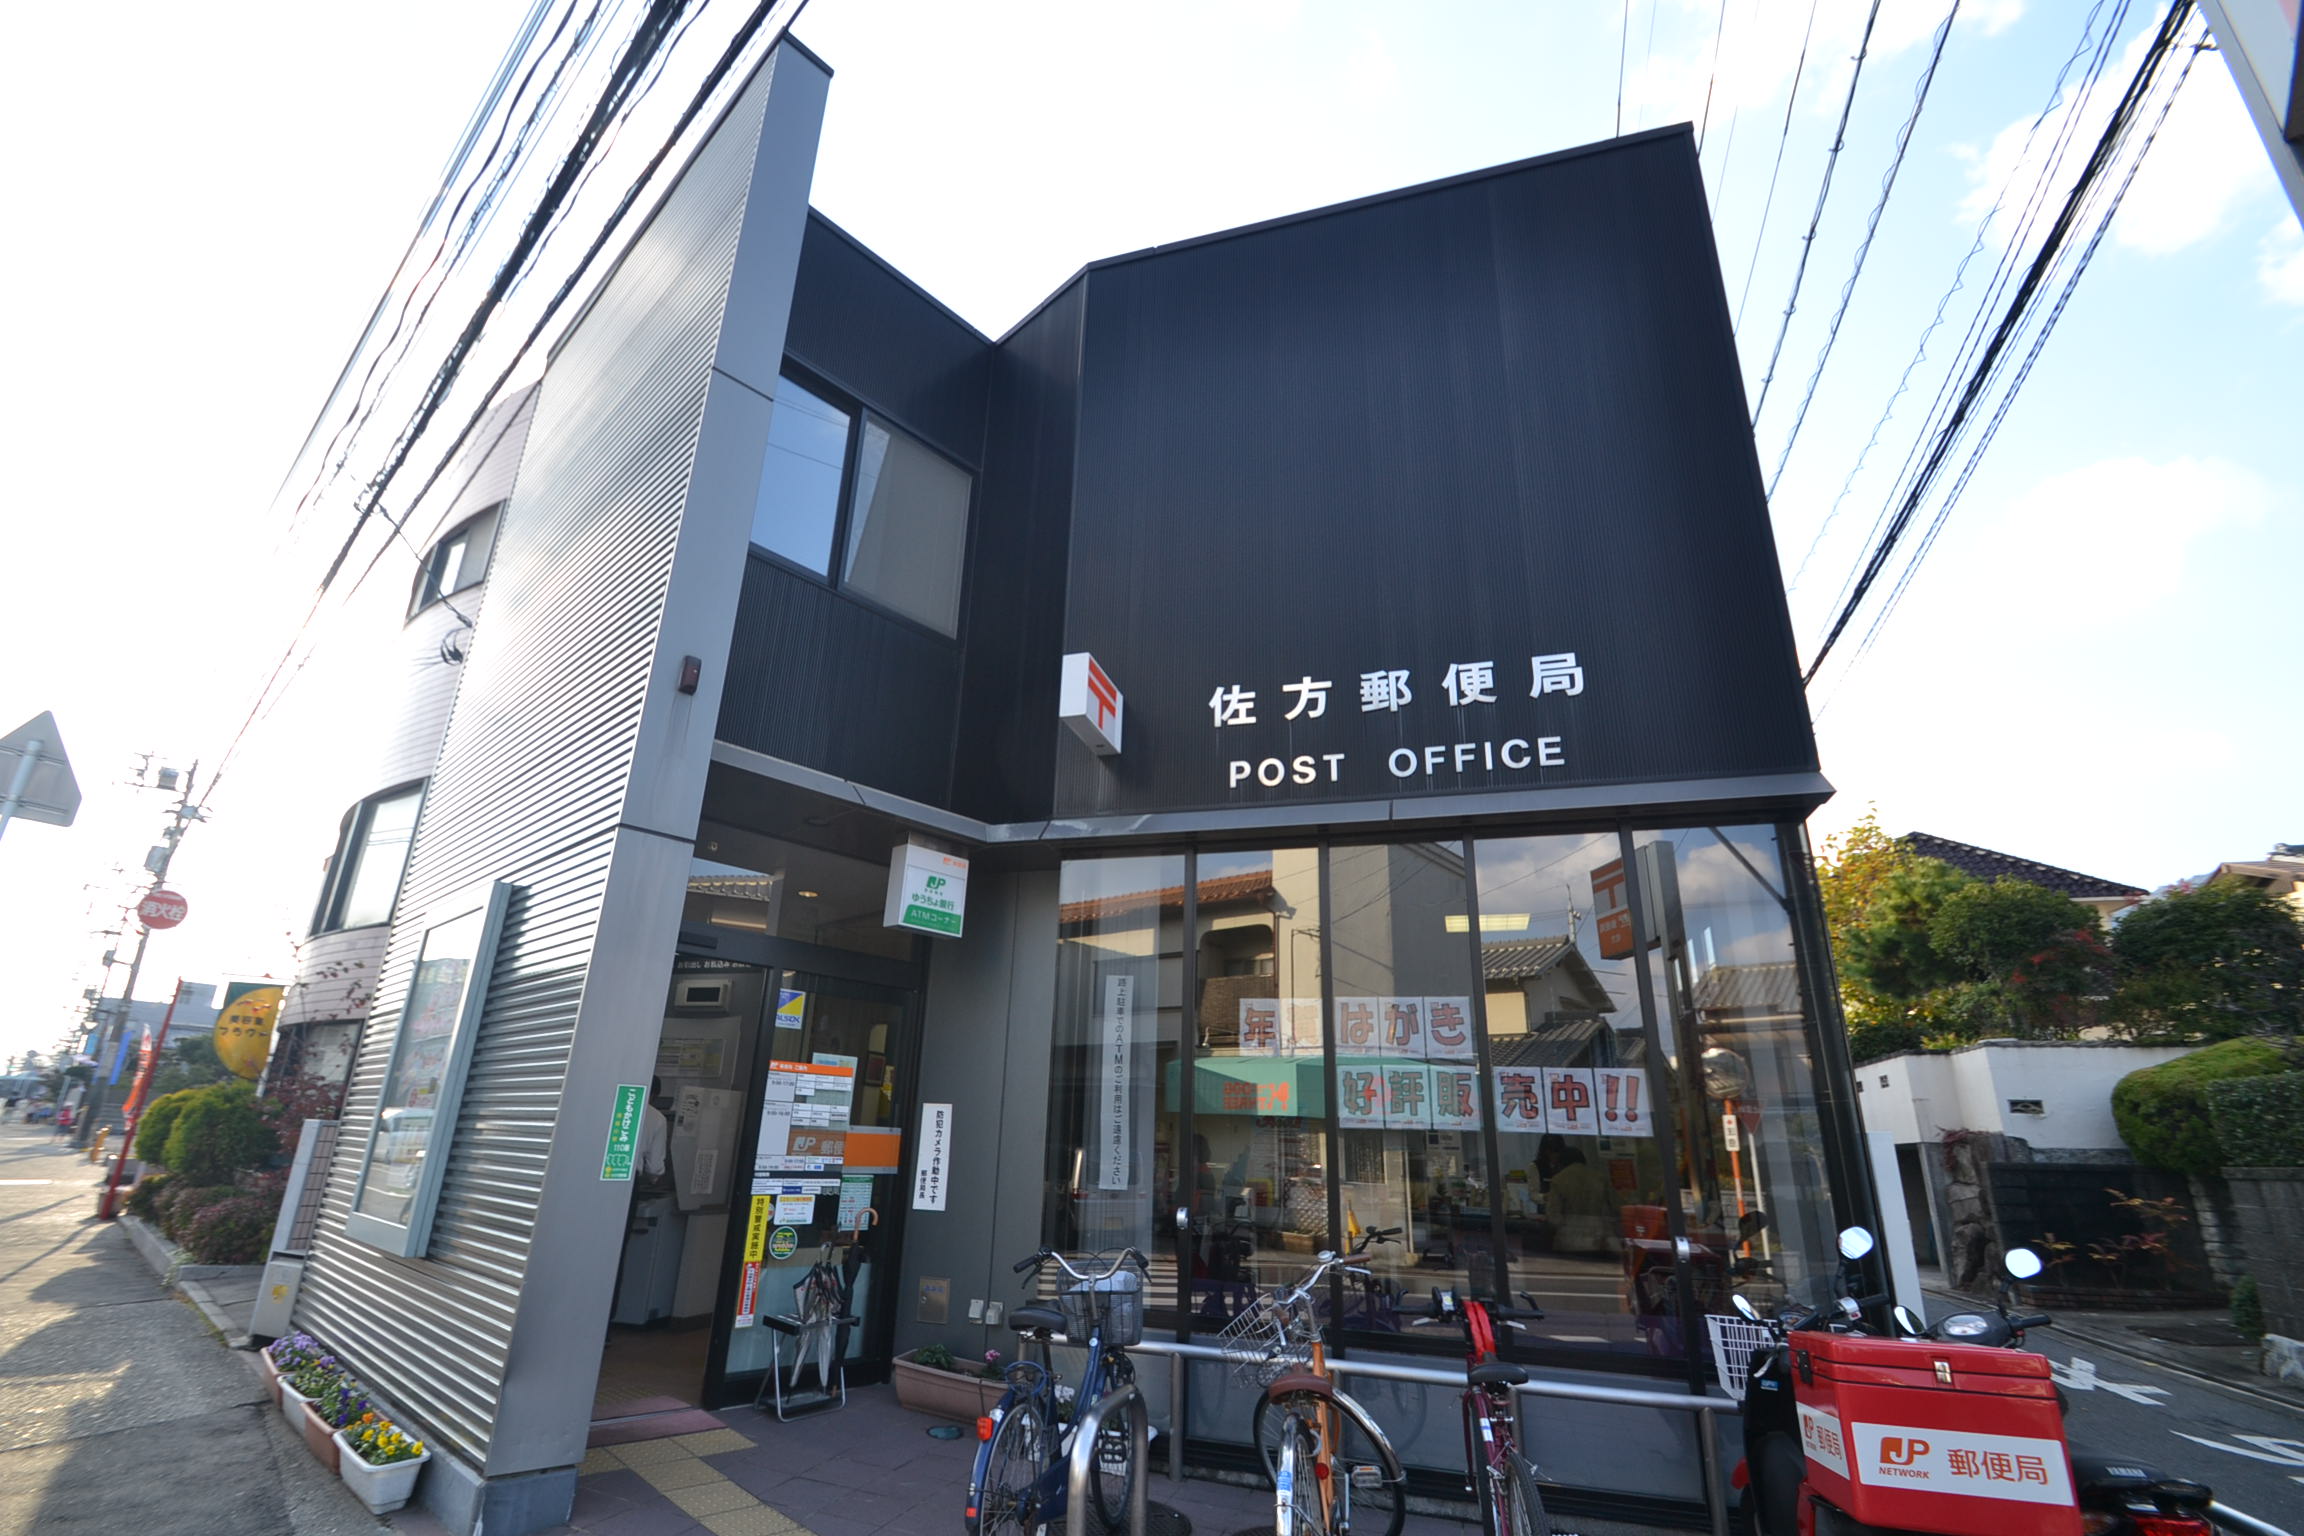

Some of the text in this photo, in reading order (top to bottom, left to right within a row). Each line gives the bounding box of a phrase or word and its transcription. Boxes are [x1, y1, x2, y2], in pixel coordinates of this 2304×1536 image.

[1208, 652, 1584, 727] 佐方郵便局
[1229, 736, 1565, 788] POST OFFICE
[911, 893, 955, 911] ゆうちょ銀行
[911, 909, 957, 925] ATMコーナー
[1343, 1071, 1640, 1122] 好評販売中!!
[928, 1105, 944, 1204] 防犯カメラ作動中です
[750, 1198, 765, 1259] 特別警戒実施中
[1880, 1436, 1930, 1466] JP
[1947, 1449, 2048, 1485] 郵便局
[1878, 1467, 1930, 1479] NETWORK
